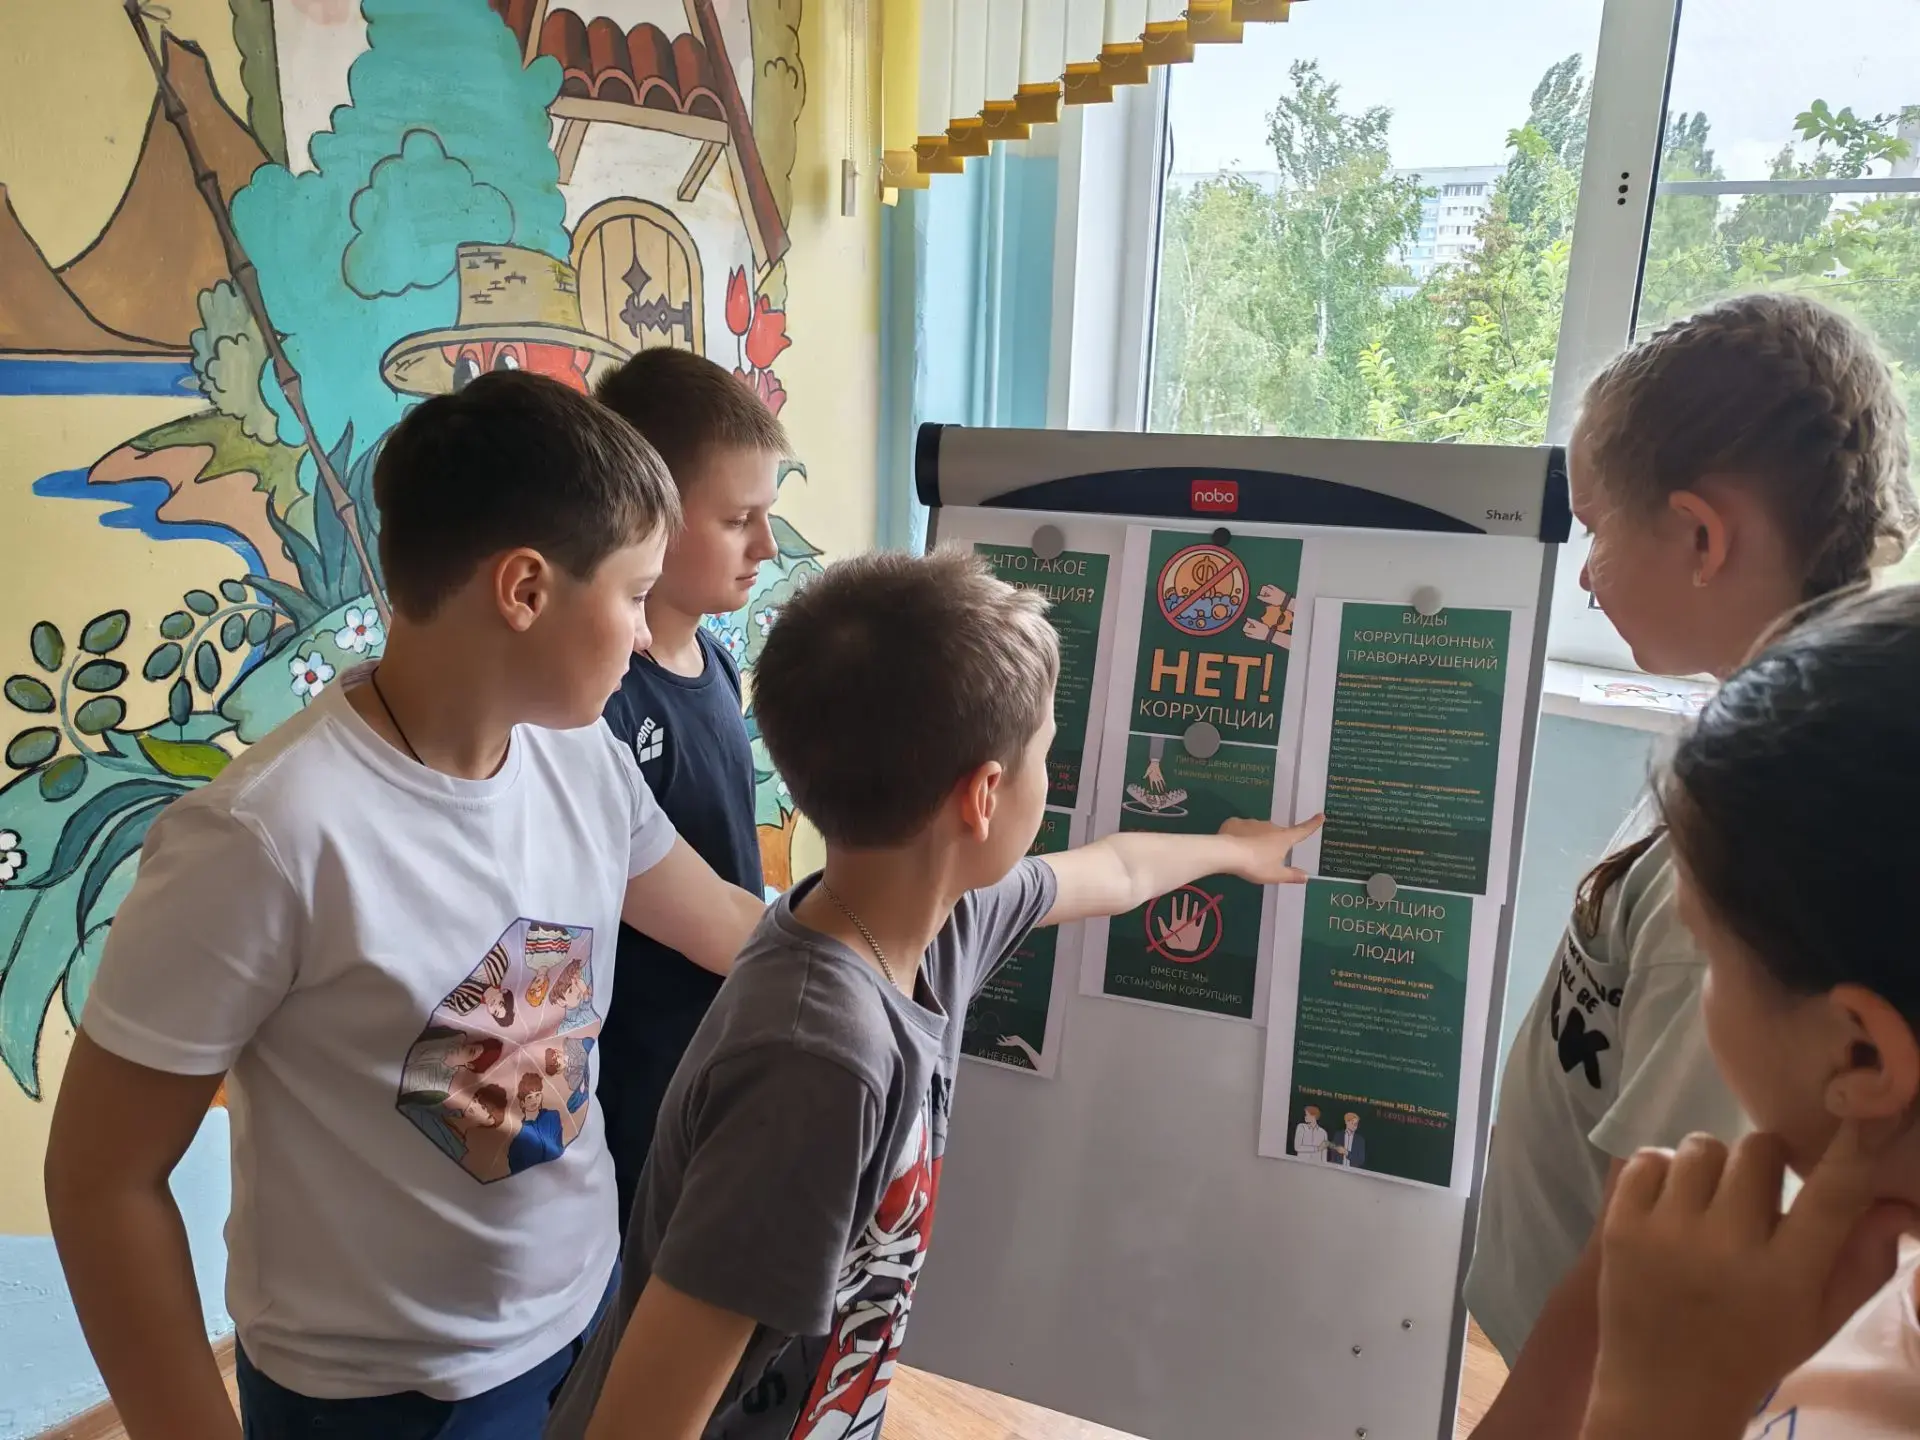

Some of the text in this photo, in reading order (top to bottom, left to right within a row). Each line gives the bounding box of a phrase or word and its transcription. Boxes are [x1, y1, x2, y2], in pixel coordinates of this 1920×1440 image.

[1194, 487, 1234, 503] nobo
[1485, 509, 1522, 521] Shark
[993, 553, 1088, 577] ЧТО ТАКОЕ
[1401, 611, 1448, 629] ВИДЫ
[1353, 630, 1496, 650] КОРРУПЦИОННЫХ
[1345, 649, 1499, 671] ПРАВОНАРУШЕНИЙ
[1149, 647, 1274, 703] НЕТ!
[1138, 698, 1275, 730] КОРРУПЦИИ
[1329, 892, 1446, 920] КОРРУПЦИЮ
[1328, 916, 1446, 944] ПОБЕЖДАЮТ
[1352, 943, 1415, 965] ЛЮДИ!
[1150, 964, 1209, 984] ВМЕСТЕ МЫ
[1114, 974, 1243, 1005] ОСТАНОВИМ КОРРУПЦИЮ
[986, 1051, 1000, 1061] НЕ
